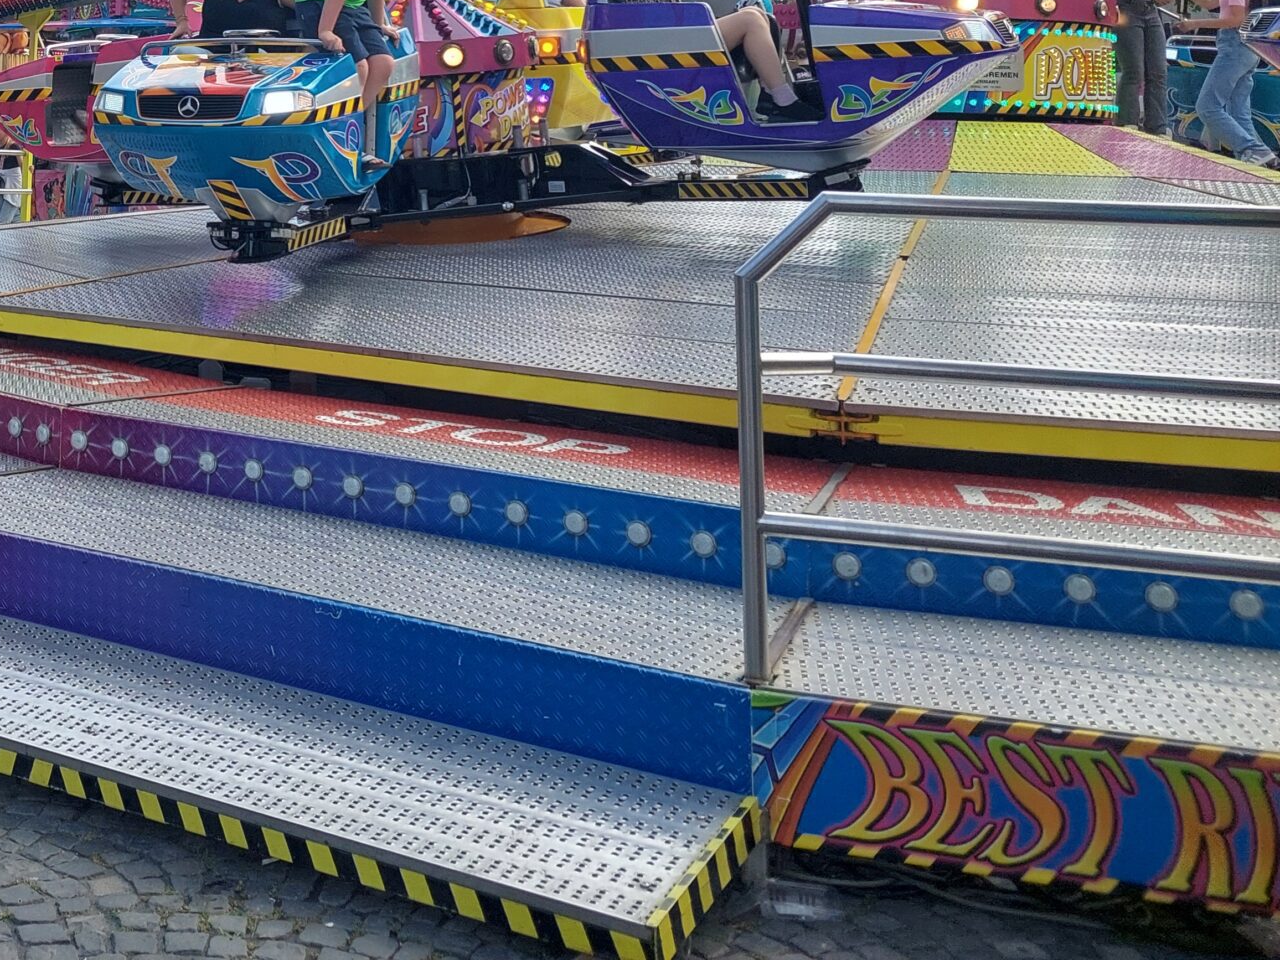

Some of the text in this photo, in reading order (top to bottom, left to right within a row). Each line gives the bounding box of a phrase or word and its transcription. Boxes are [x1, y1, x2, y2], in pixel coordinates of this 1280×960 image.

[315, 409, 632, 455] STOP
[823, 717, 1280, 904] BEST RI
